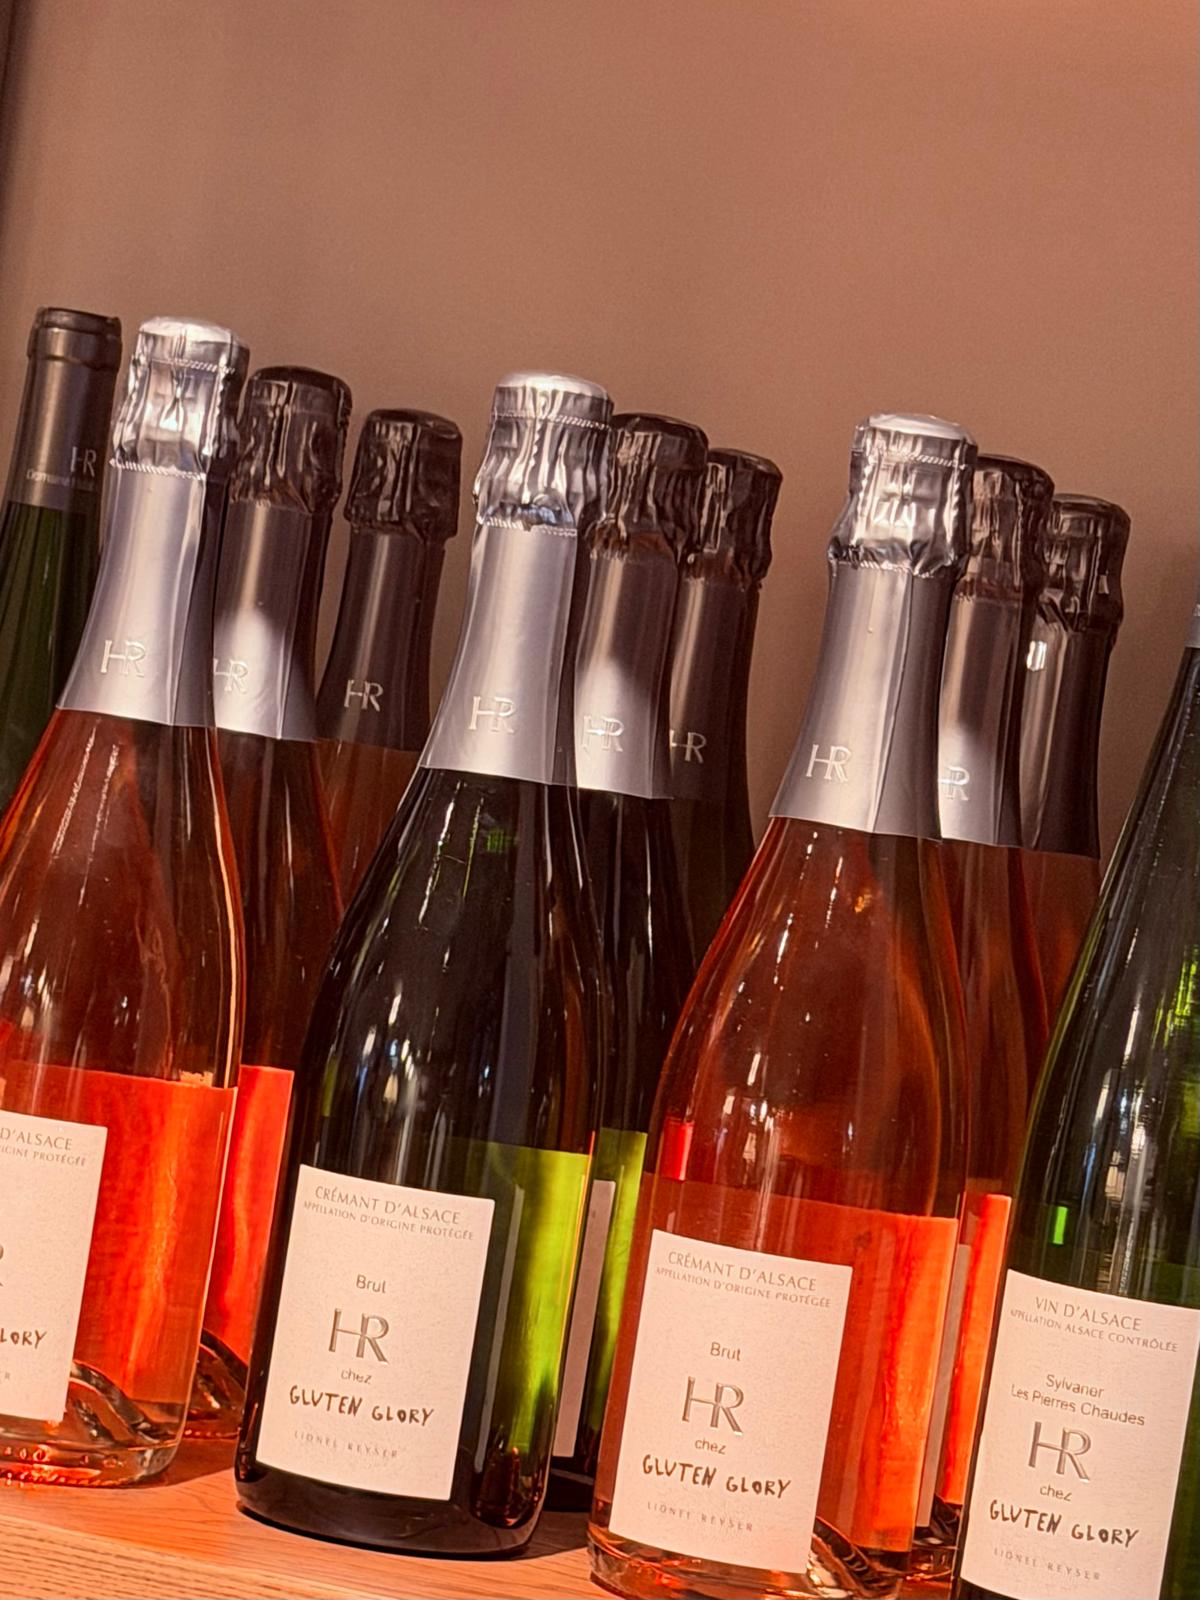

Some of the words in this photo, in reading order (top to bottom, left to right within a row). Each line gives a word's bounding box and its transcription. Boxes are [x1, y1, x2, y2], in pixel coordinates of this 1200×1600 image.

[100, 640, 146, 677] HR
[344, 679, 384, 712] HR
[468, 695, 516, 733] HR
[580, 715, 625, 752] HR
[806, 743, 853, 783] HR
[0, 1127, 72, 1151] D'ALSACE
[315, 1185, 380, 1211] CRÉMANT
[384, 1200, 461, 1225] D'ALSACE
[360, 1214, 416, 1232] D'ORIGINE
[419, 1225, 474, 1241] PROTÉGÉE
[356, 1274, 387, 1294] Brut
[655, 1268, 711, 1289] APPELLATION
[713, 1281, 771, 1300] D'ORIGINE
[775, 1292, 832, 1308] PROTÉGÉE
[668, 1251, 735, 1278] CRÉMANT
[739, 1267, 817, 1292] D'ALSACE
[1035, 1296, 1059, 1315] VIN
[1063, 1303, 1143, 1332] D'ALSACE
[328, 1308, 390, 1365] HR
[710, 1341, 742, 1362] Brut
[1064, 1323, 1104, 1339] ALSACE
[1108, 1332, 1179, 1353] CONTRÔLÉE
[341, 1368, 372, 1385] chez
[1045, 1374, 1104, 1399] Sylvaner
[289, 1385, 363, 1417] GLUTEN
[371, 1405, 434, 1427] GLORY
[681, 1376, 745, 1436] HR
[1011, 1384, 1029, 1401] Les
[1032, 1390, 1076, 1413] Pierres
[1081, 1402, 1146, 1426] Chaudes
[694, 1438, 727, 1455] chez
[1028, 1421, 1092, 1483] HR
[642, 1454, 717, 1488] GLUTEN
[726, 1476, 792, 1499] GLORY
[1039, 1483, 1073, 1502] chez
[990, 1500, 1062, 1535] GLUTEN
[1071, 1524, 1140, 1548] GLORY
